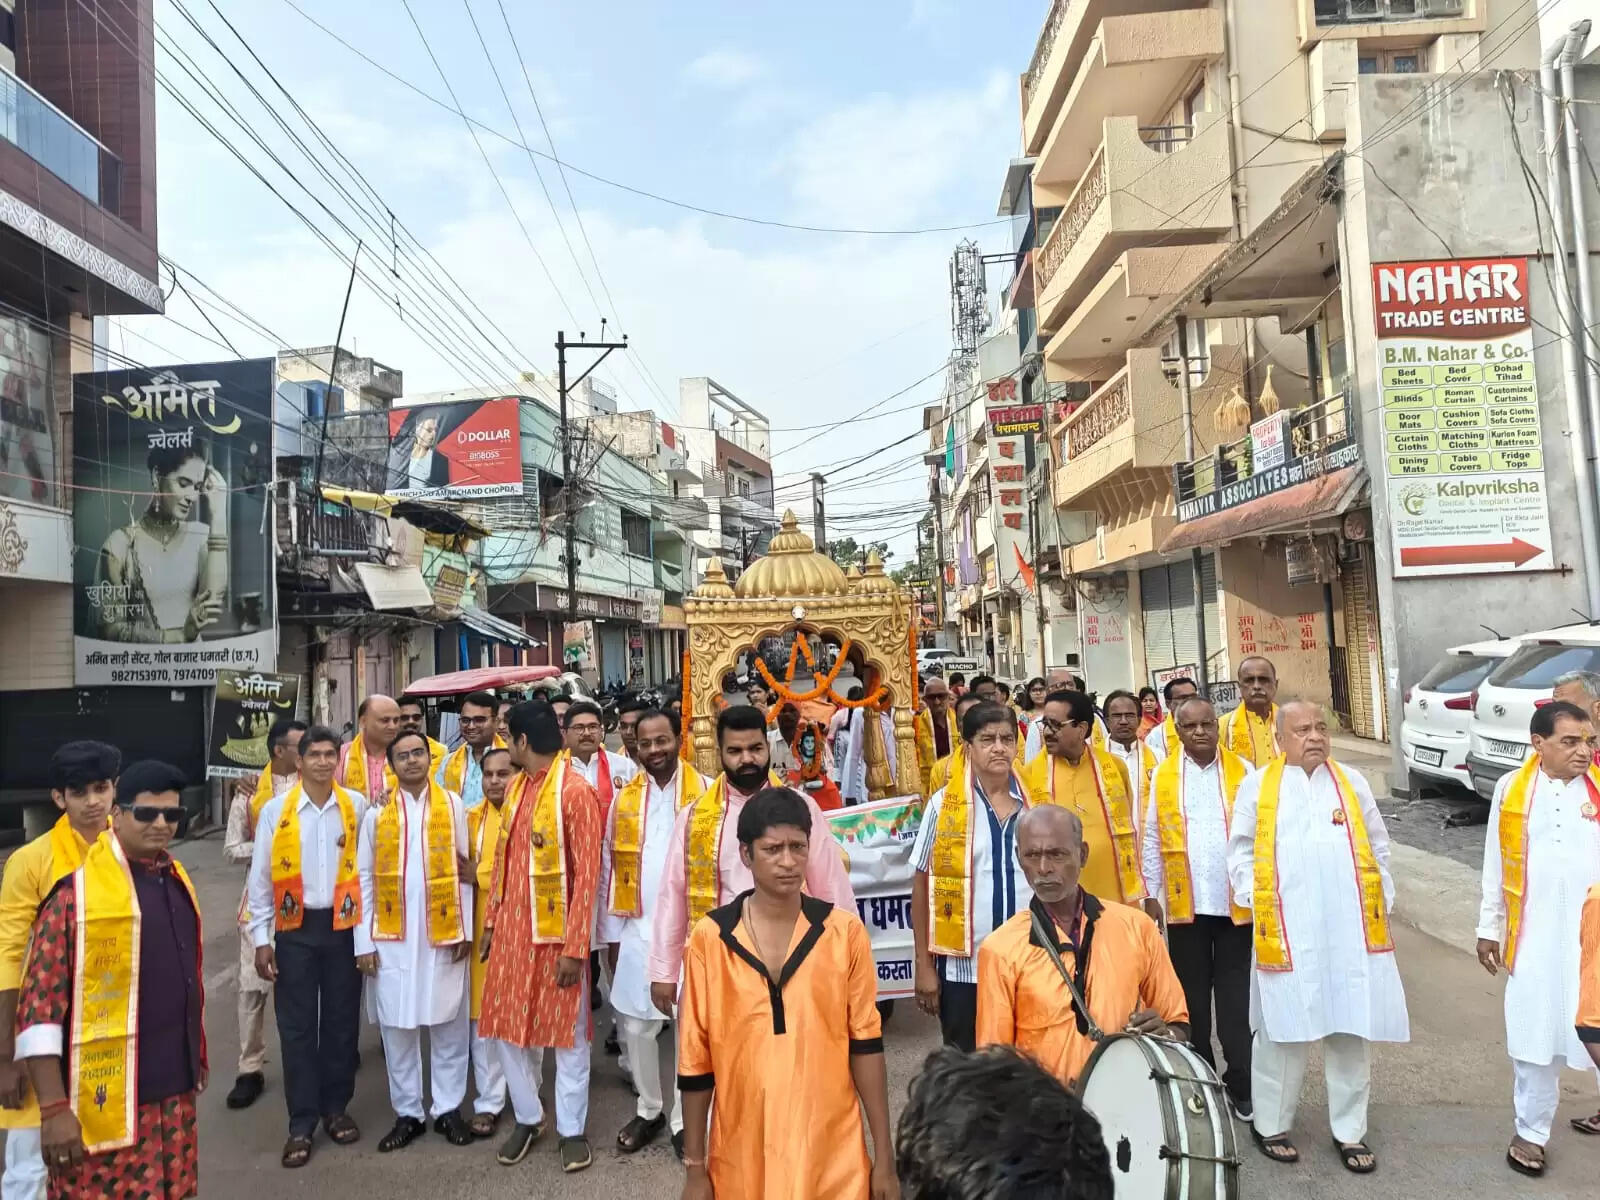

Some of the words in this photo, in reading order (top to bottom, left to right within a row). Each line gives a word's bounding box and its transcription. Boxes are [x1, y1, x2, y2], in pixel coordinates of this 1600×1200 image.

[1379, 264, 1522, 305] NAHAR
[1381, 310, 1445, 328] TRADE
[1450, 307, 1526, 326] CENTRE
[1385, 347, 1421, 363] B.M.
[1427, 345, 1477, 361] Nahar
[1483, 343, 1495, 359] &
[1502, 343, 1528, 359] Co.
[1398, 369, 1416, 377] Bed
[1445, 375, 1471, 383] Cover
[1488, 386, 1533, 394] Customized
[102, 370, 241, 434] अमित
[1394, 395, 1423, 403] Blinds
[1442, 410, 1480, 418] Cushion
[1446, 419, 1478, 427] Covers
[1509, 416, 1535, 424] Covers
[148, 427, 195, 449] ज्वेलर्स
[468, 429, 511, 442] DOLLAR
[1395, 435, 1429, 443] Curtain
[1441, 432, 1484, 441] Matching
[1495, 438, 1534, 446] Mattress
[1501, 452, 1530, 460] Fridge
[1399, 458, 1428, 466] Dining
[1506, 460, 1527, 468] Tops
[1450, 463, 1481, 471] Covers
[1221, 467, 1288, 508] ASSOCIATES
[1437, 479, 1539, 498] Kalpvriksha
[1479, 497, 1510, 506] Implant
[85, 651, 108, 666] अमित
[154, 649, 171, 664] गोल
[173, 650, 198, 664] बाजार
[200, 648, 229, 664] धमतरी
[111, 669, 171, 683] 9827153970,
[228, 674, 286, 700] अमित
[877, 960, 912, 981] करता
